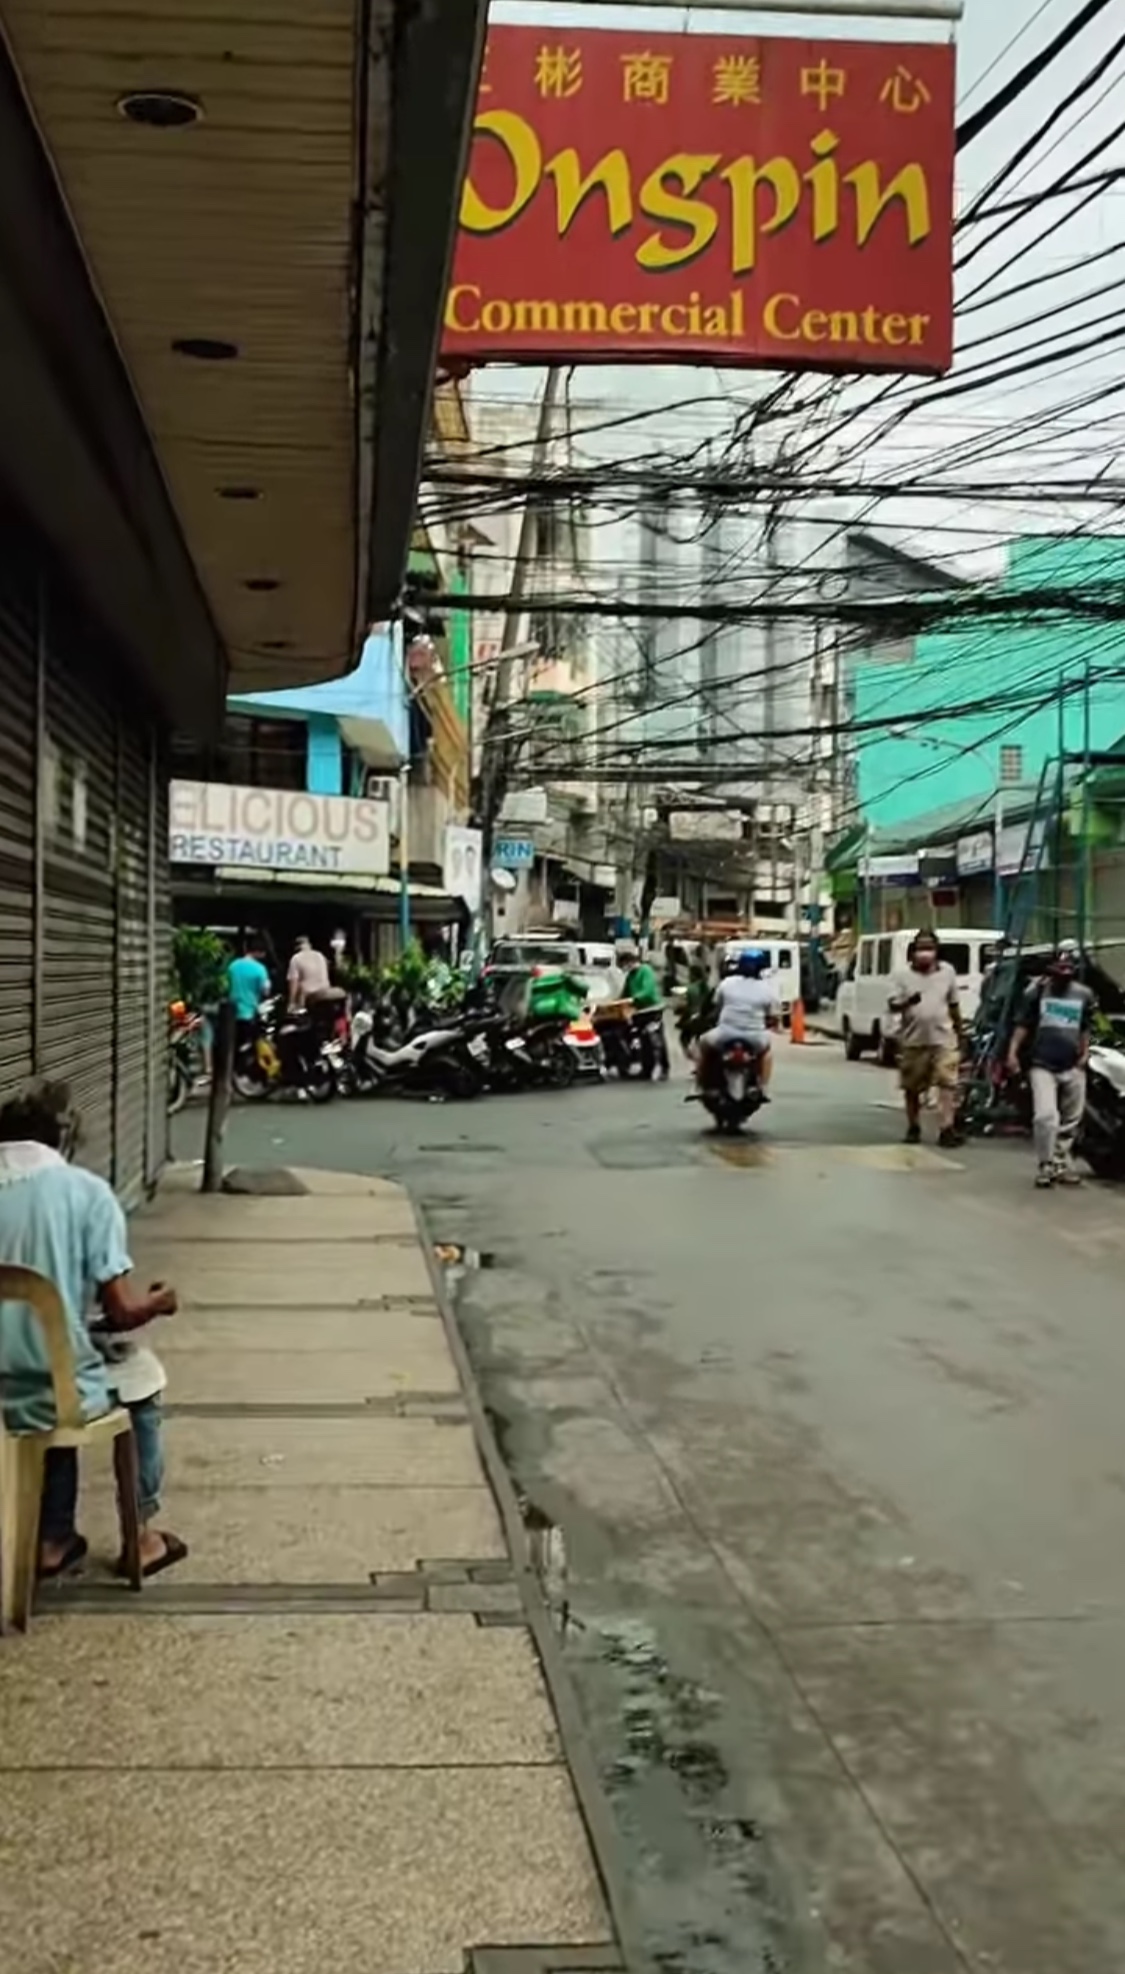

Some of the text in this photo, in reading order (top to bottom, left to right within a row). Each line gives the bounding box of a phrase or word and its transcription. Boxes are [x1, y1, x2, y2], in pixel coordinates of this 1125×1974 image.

[459, 110, 932, 276] Ongpin
[444, 284, 931, 346] Commercial Center
[171, 834, 342, 868] RESTAURANT
